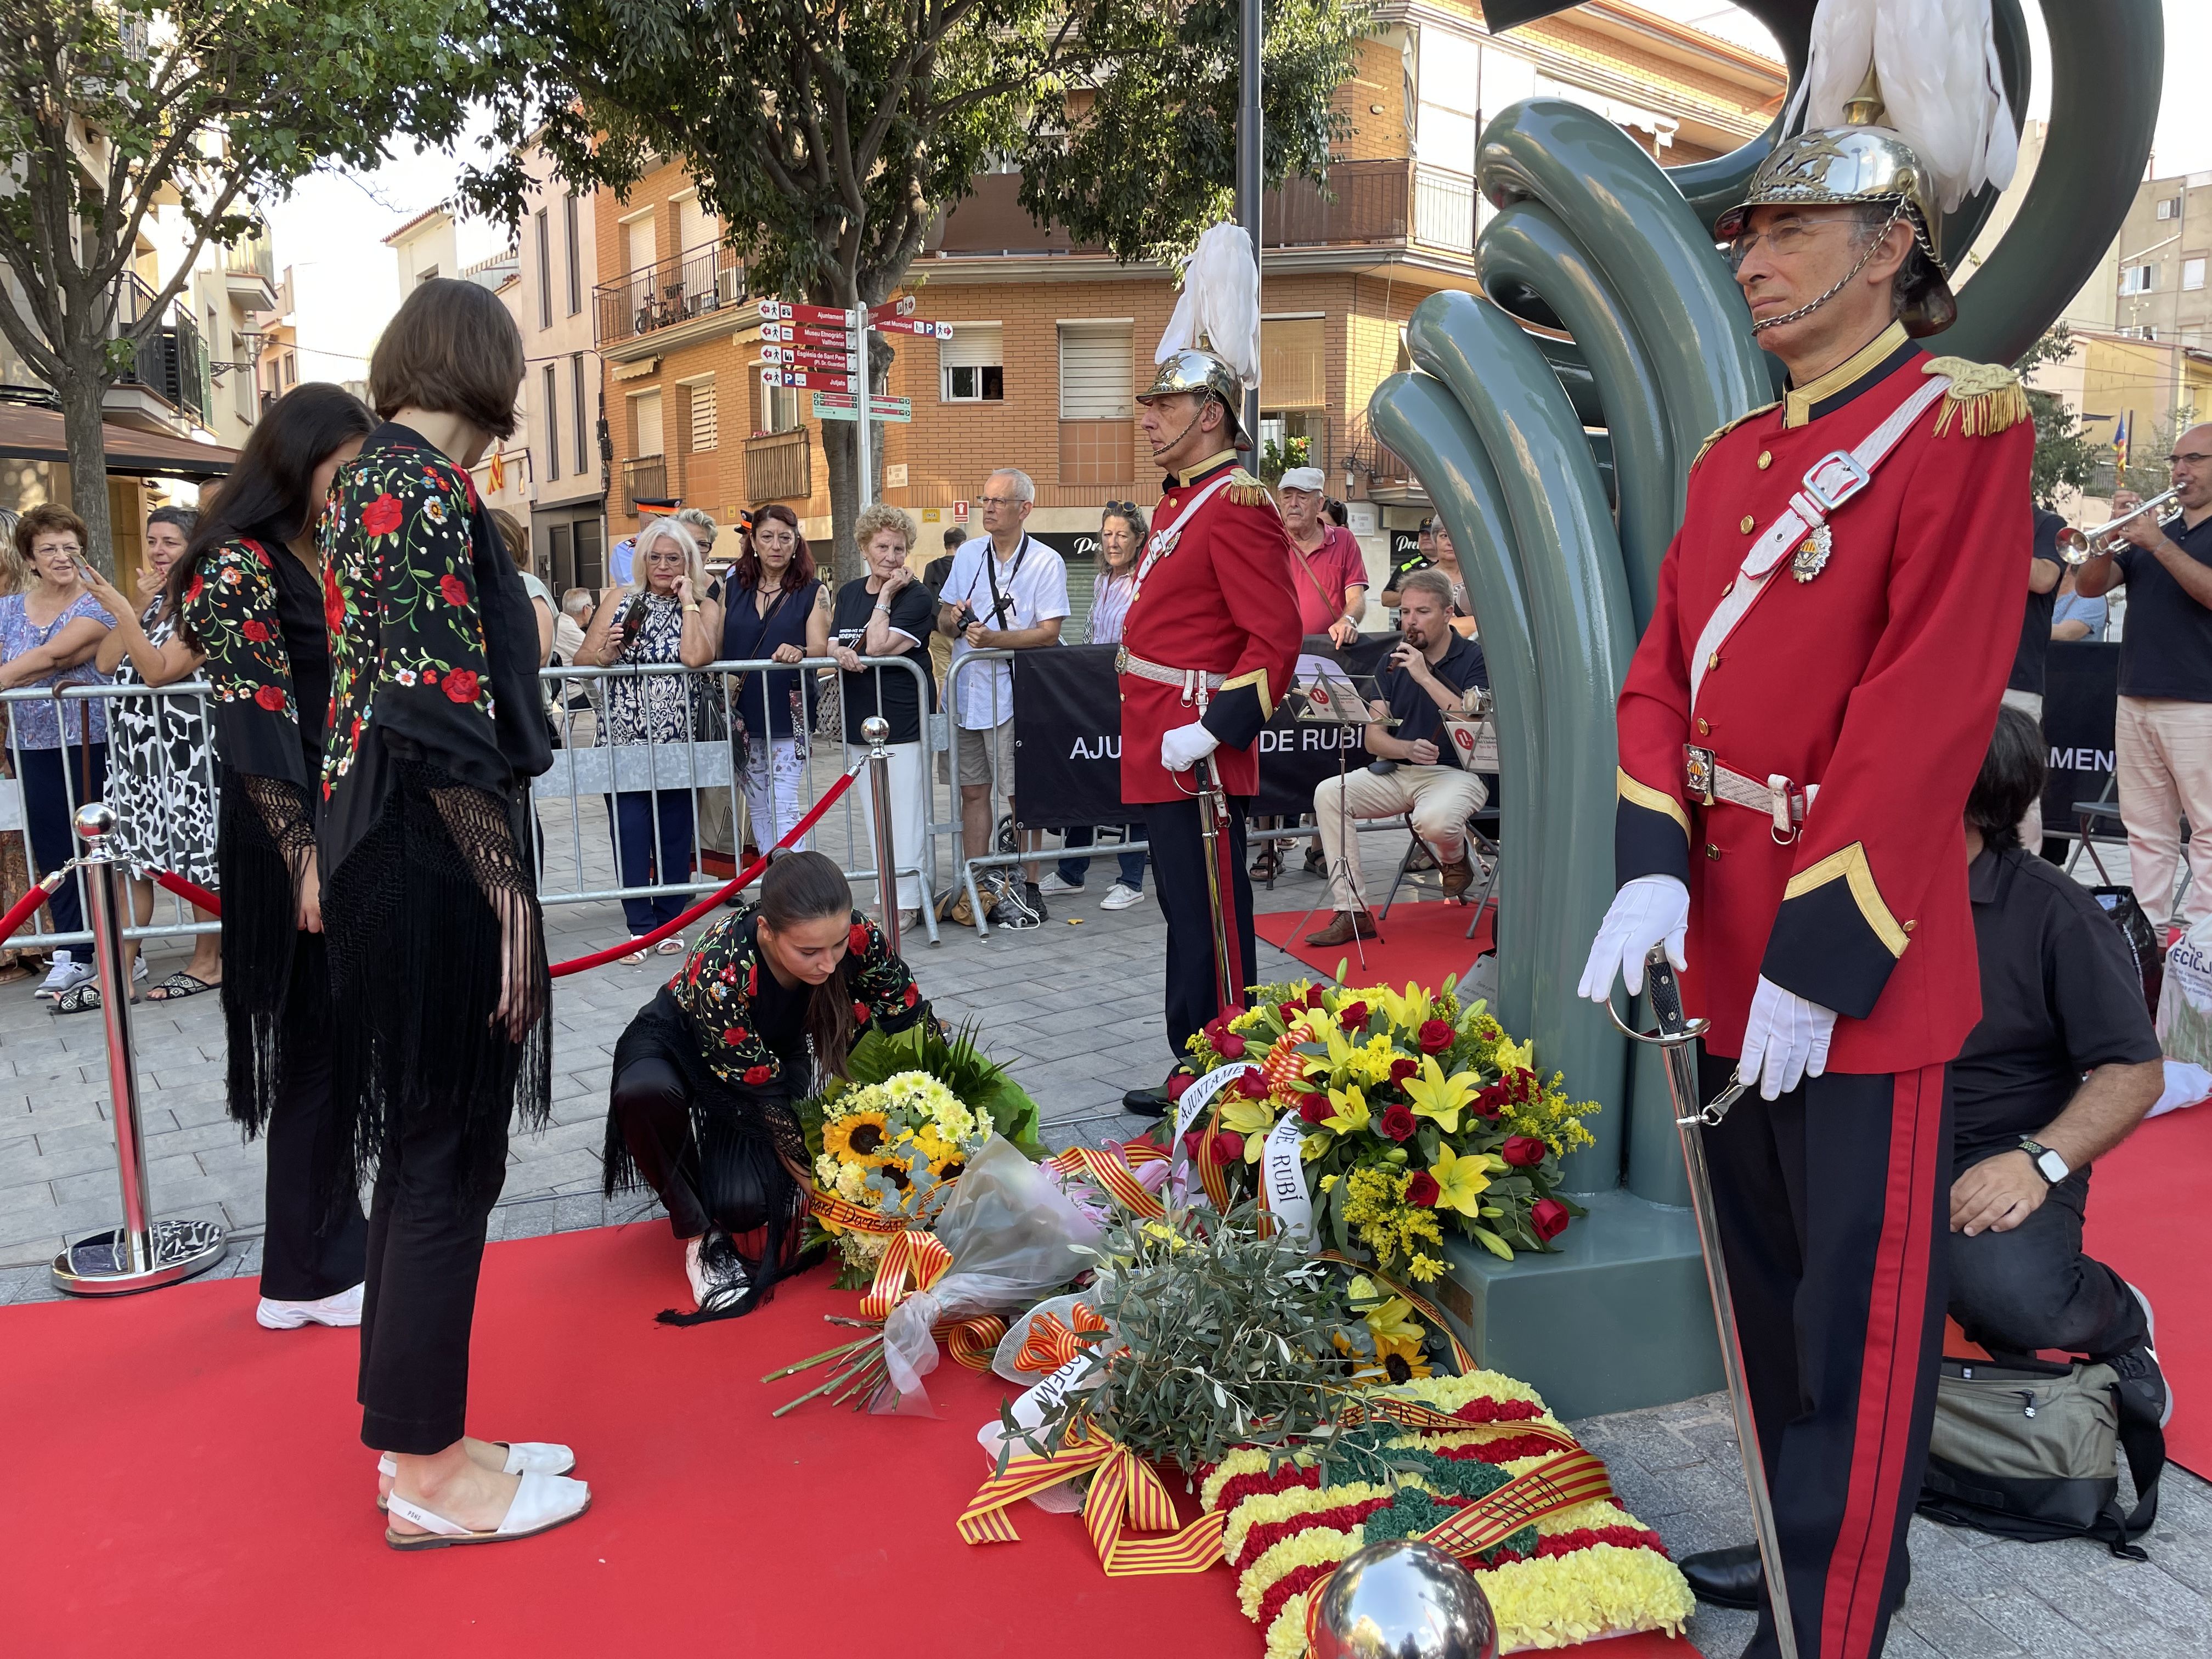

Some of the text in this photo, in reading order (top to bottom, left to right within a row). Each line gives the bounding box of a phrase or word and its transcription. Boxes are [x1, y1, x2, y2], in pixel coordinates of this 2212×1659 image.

[817, 312, 844, 320] Ajuntament
[891, 320, 912, 329] Municipal
[830, 379, 845, 387] Jutjats
[1260, 730, 1294, 752] DE
[1302, 723, 1362, 751] RUBÍ
[2045, 746, 2114, 772] MEN
[1181, 1064, 1262, 1125] AJUNTAMET
[1273, 1126, 1299, 1146] DE
[1272, 1154, 1306, 1204] RUBÍ
[408, 1510, 421, 1521] PONS
[1431, 1525, 1481, 1554] PE
